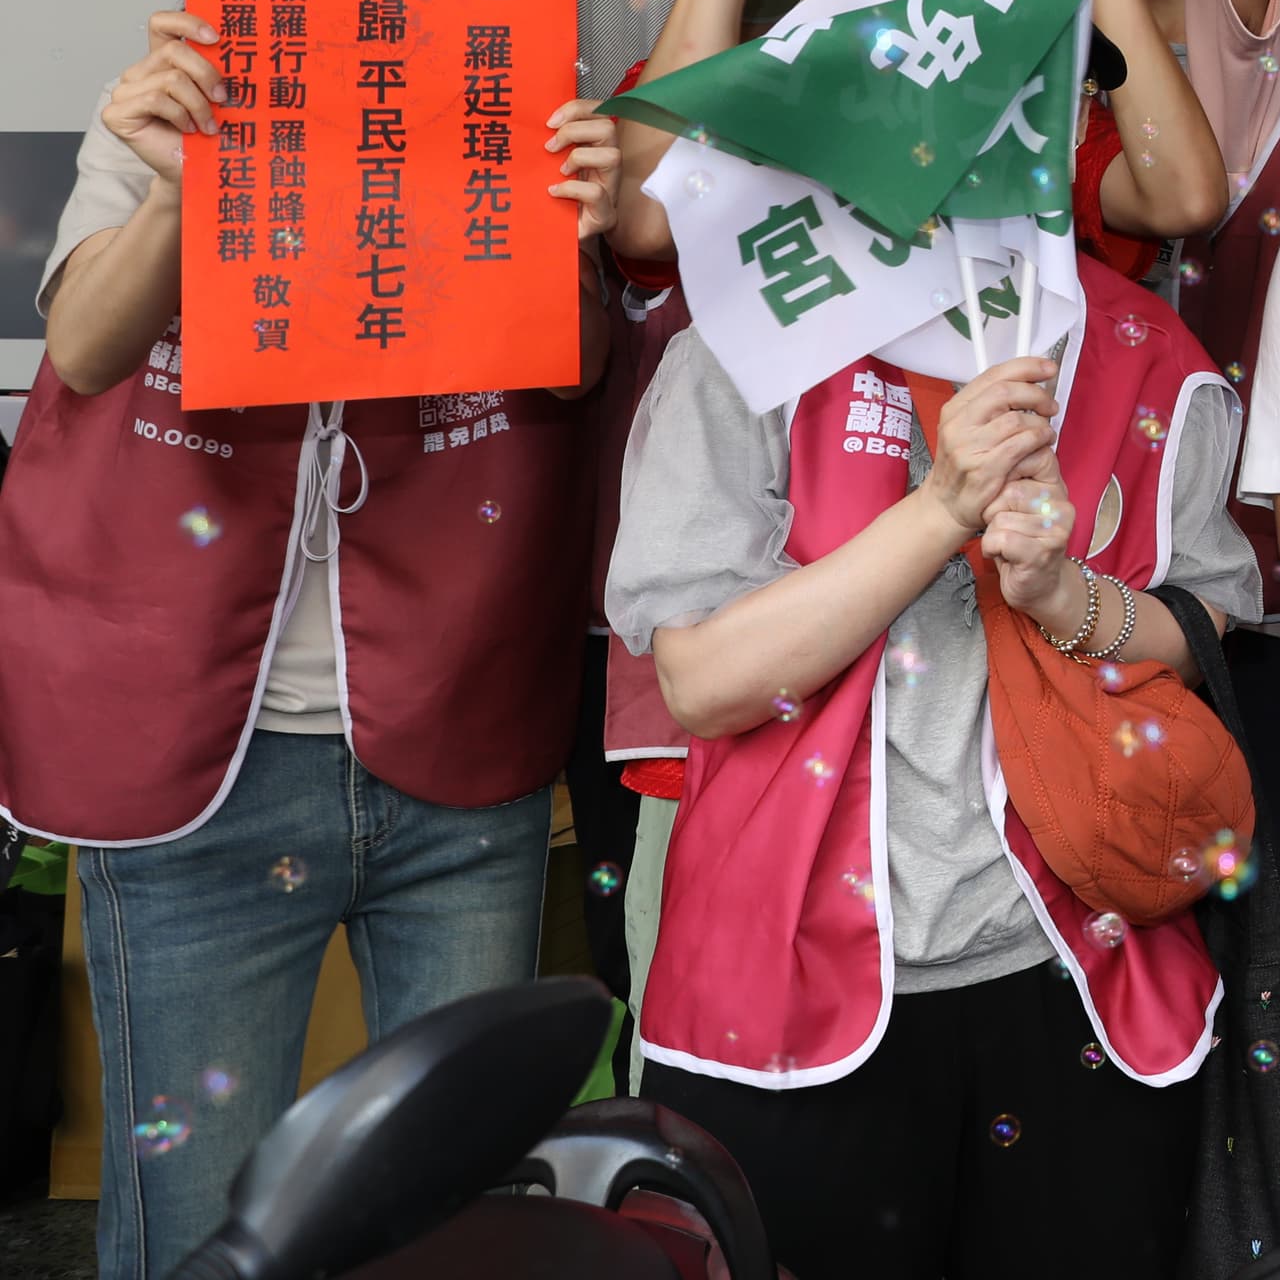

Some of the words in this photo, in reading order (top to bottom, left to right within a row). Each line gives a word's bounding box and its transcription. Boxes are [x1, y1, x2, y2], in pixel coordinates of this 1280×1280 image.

[216, 119, 257, 263] 卸廷蜂群
[267, 120, 307, 262] 羅蝕蜂群
[355, 59, 408, 350] 平民百姓七年
[462, 24, 514, 263] 羅廷瑋先生
[252, 274, 292, 353] 敬賀
[423, 412, 510, 453] 罷免問我
